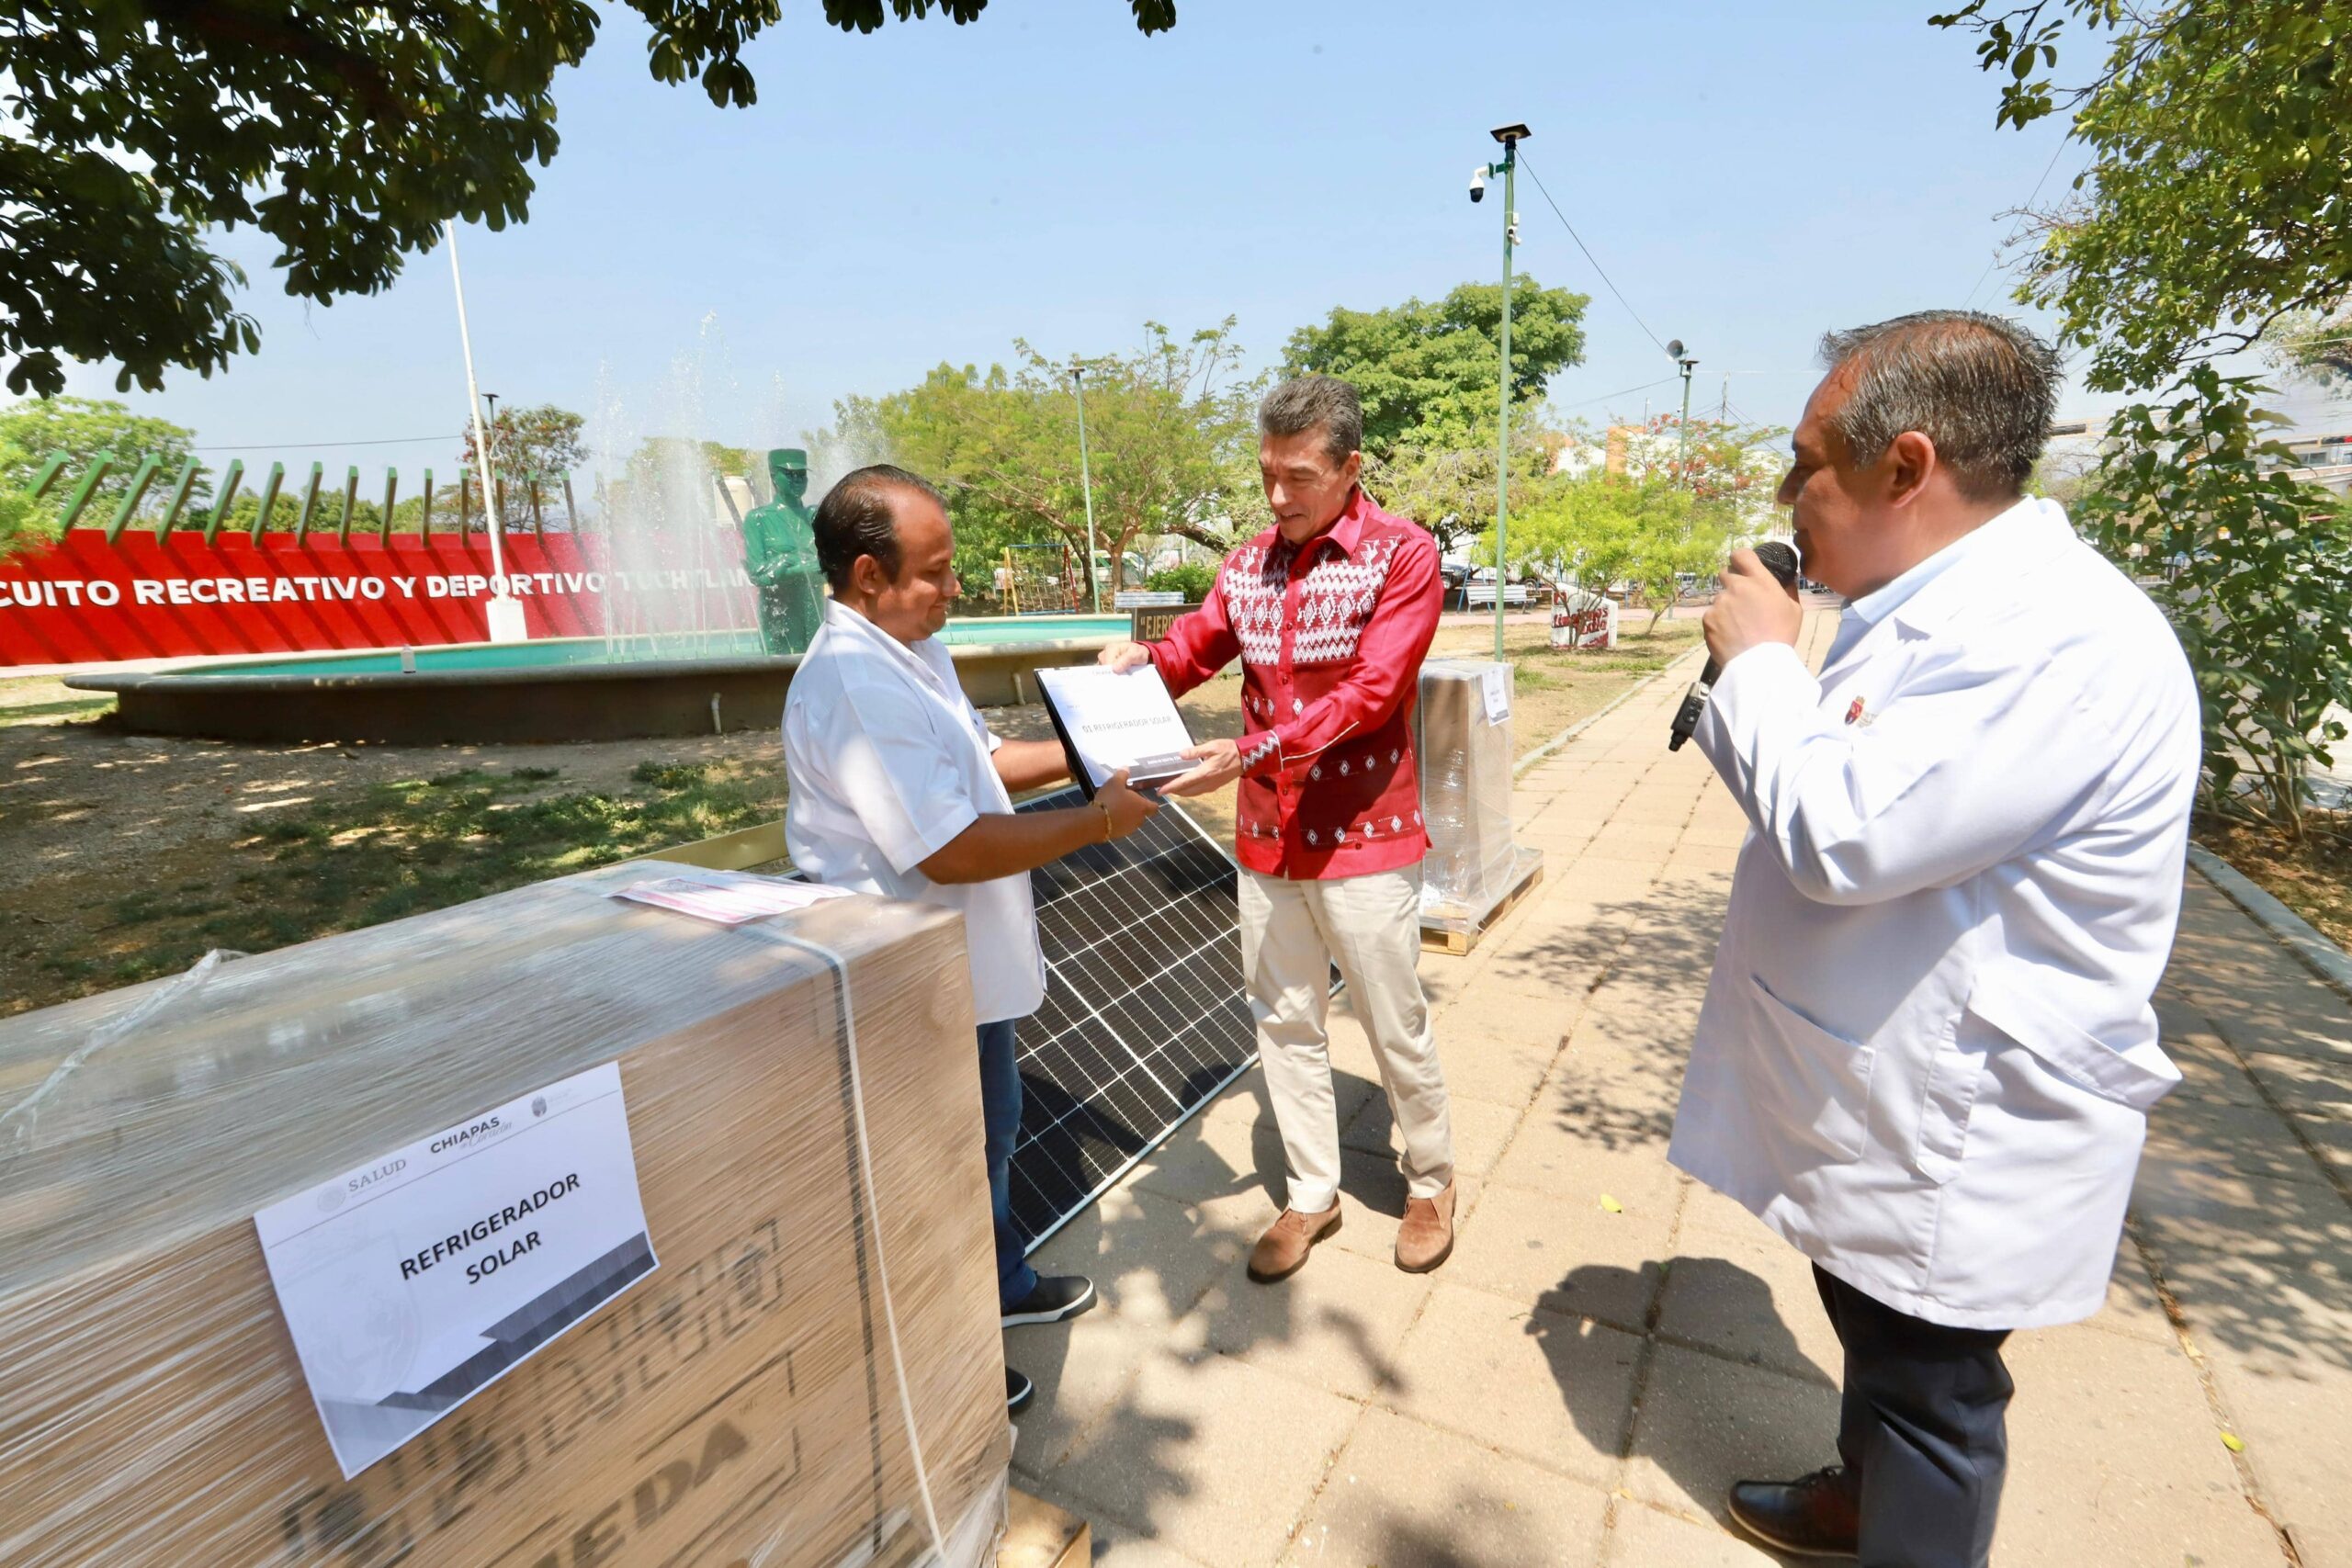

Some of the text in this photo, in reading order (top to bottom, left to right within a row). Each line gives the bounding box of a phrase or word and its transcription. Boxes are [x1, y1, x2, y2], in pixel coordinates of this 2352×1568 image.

[133, 577, 386, 604] RECREATIVO
[391, 576, 416, 598] Y
[426, 572, 605, 598] DEPORTIVO
[1094, 717, 1149, 733] REFRIGERADOR
[1148, 715, 1172, 727] SOLAR
[430, 1116, 501, 1154] CHIAPAS
[348, 1158, 407, 1192] SALUD
[400, 1172, 581, 1281] REFRIGERADOR
[465, 1230, 542, 1285] SOLAR
